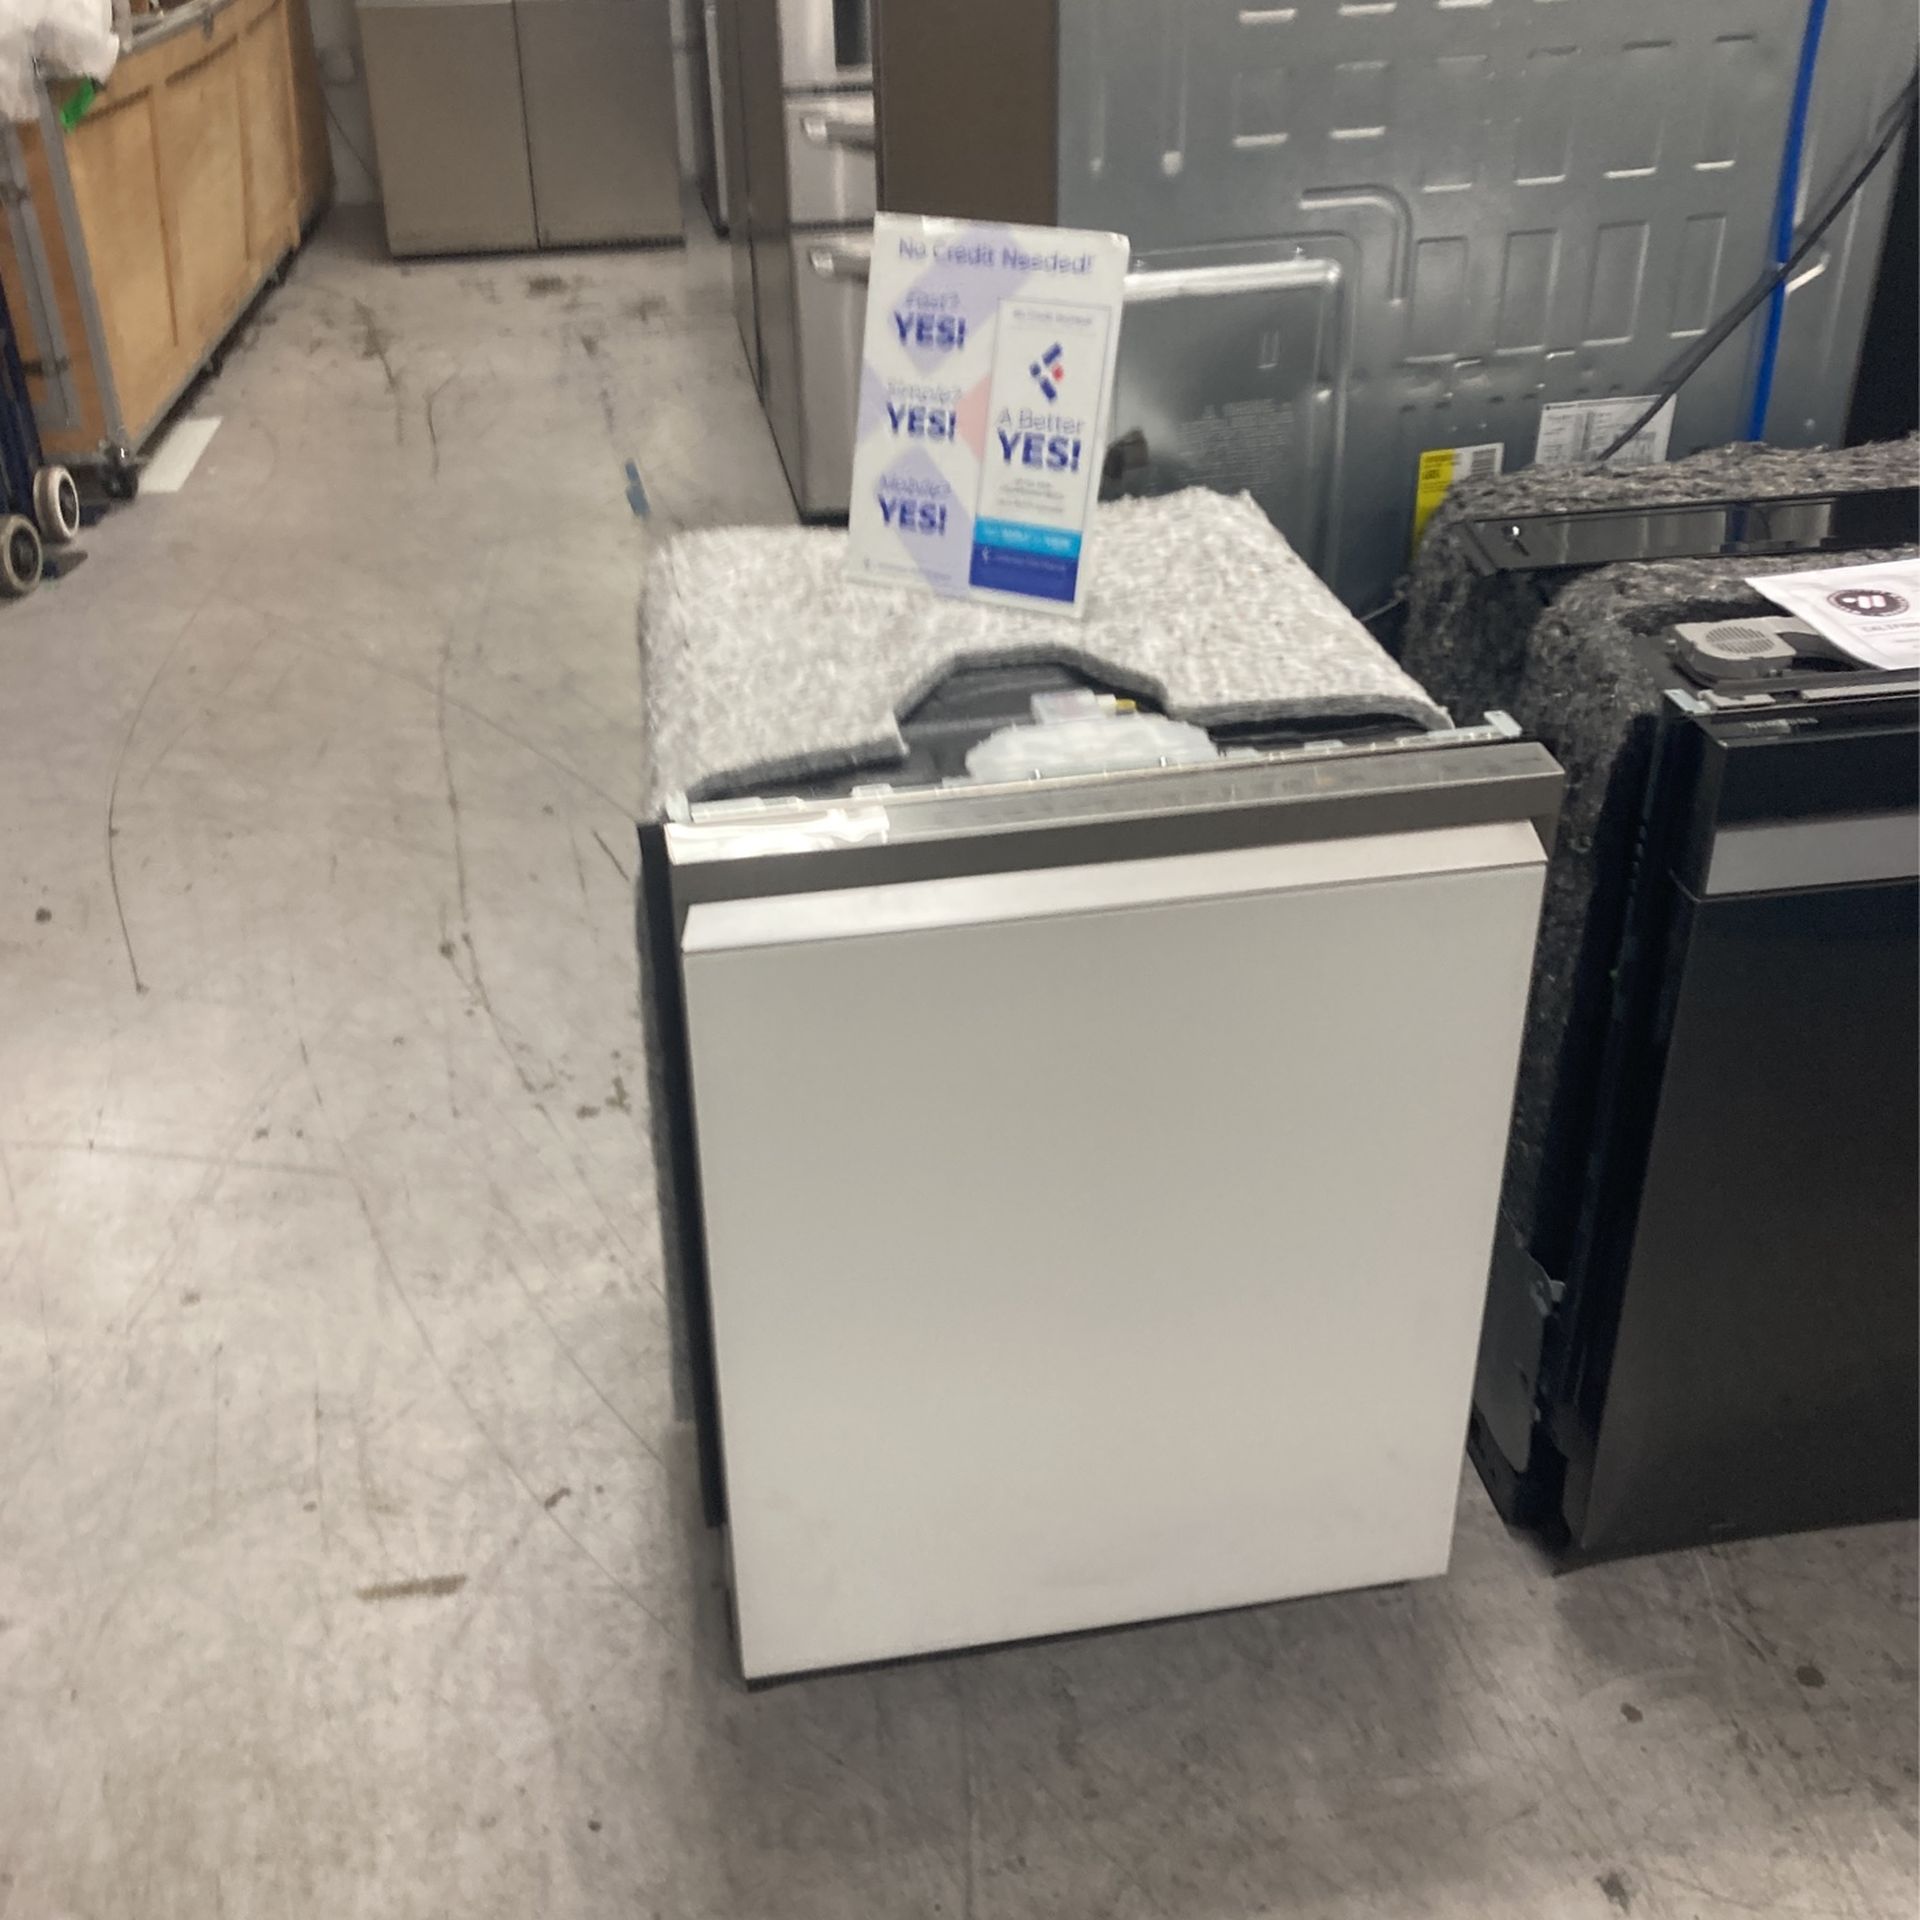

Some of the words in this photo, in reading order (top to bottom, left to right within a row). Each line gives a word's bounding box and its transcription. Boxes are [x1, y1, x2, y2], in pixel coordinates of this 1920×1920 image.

[898, 239, 926, 260] No
[933, 242, 995, 267] Credit
[1002, 250, 1094, 275] Needed!
[894, 310, 966, 350] YES!
[886, 402, 957, 442] YES!
[999, 411, 1013, 427] A
[1019, 409, 1086, 435] Better
[997, 429, 1082, 473] YES!
[877, 494, 948, 537] YES!
